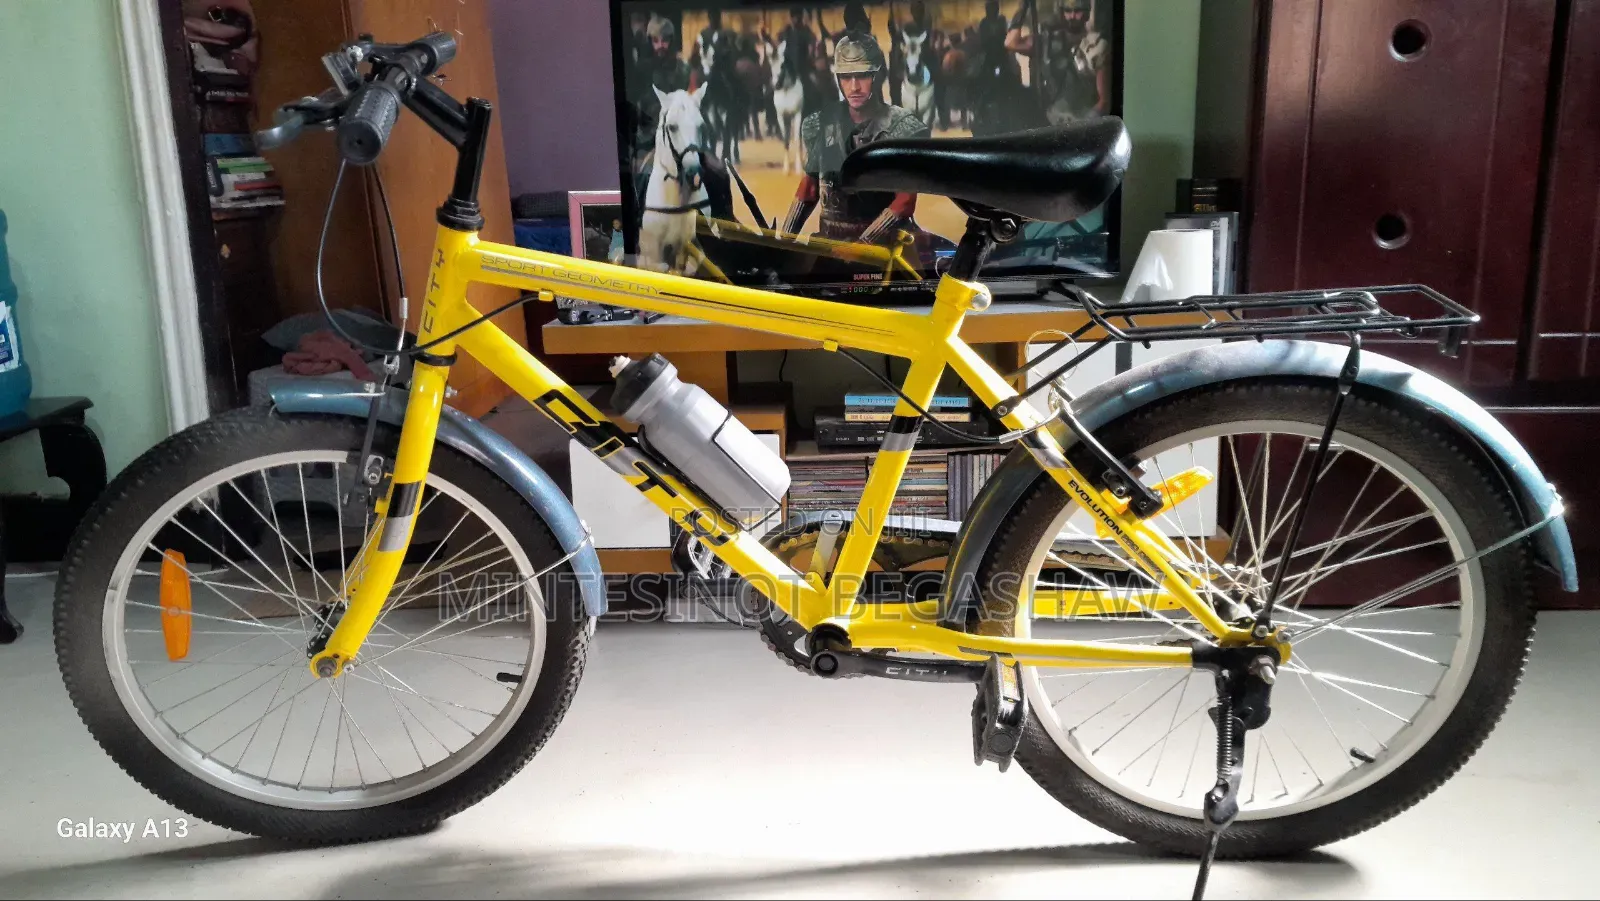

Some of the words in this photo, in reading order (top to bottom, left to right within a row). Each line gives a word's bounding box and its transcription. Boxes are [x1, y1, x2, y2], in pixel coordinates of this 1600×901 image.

[481, 254, 550, 275] SPORT
[552, 268, 665, 295] GEOMETRY
[1067, 479, 1124, 536] EVOLUTION
